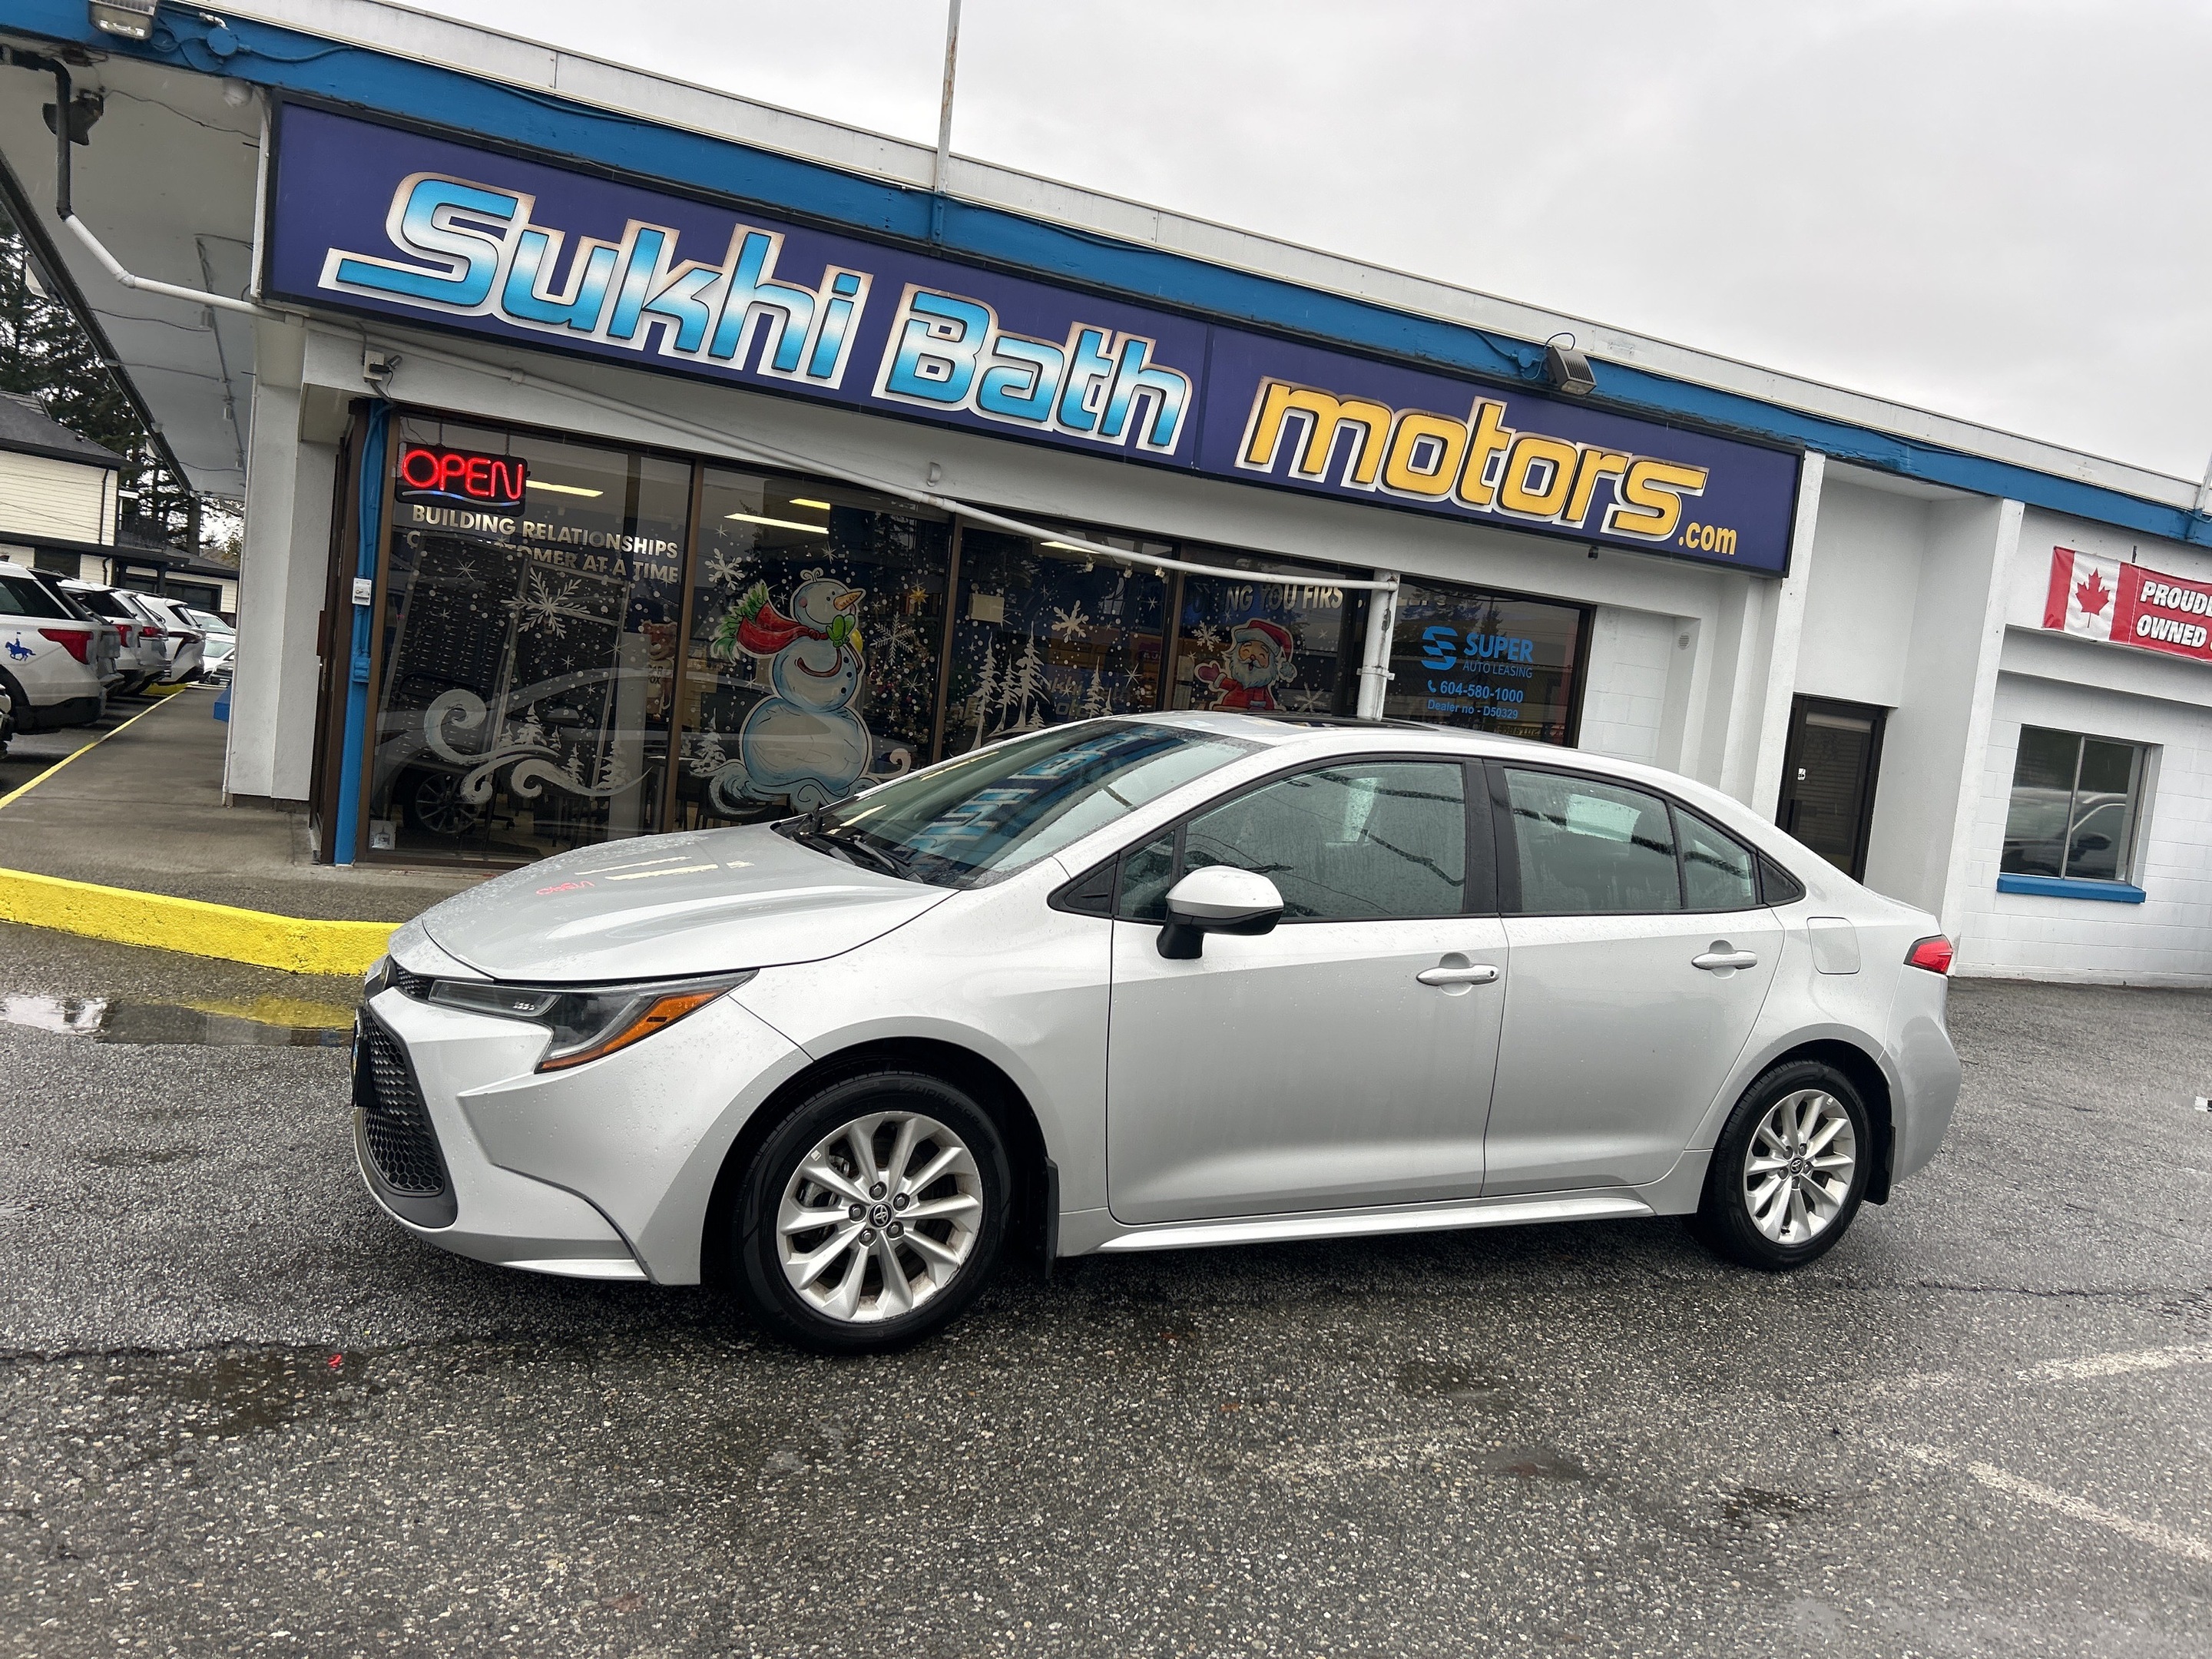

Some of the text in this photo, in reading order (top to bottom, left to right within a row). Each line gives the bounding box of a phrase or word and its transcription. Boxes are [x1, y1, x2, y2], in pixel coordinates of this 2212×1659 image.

[318, 171, 1737, 556] Sukhi Bath motors .com
[402, 449, 524, 500] OPEN
[412, 504, 679, 559] BUILDING RELATIONSHIPS
[582, 555, 608, 573] AT
[612, 558, 628, 576] A
[633, 561, 679, 583] TIME
[1260, 583, 1298, 611] YOU
[2135, 614, 2208, 648] OWNED
[1463, 632, 1534, 663] SUPER
[1462, 659, 1533, 679] AUTO LEASING
[1440, 680, 1524, 704] 604-580-1000
[1427, 699, 1460, 713] Dealer
[1462, 705, 1475, 715] no
[1483, 705, 1518, 720] D50329
